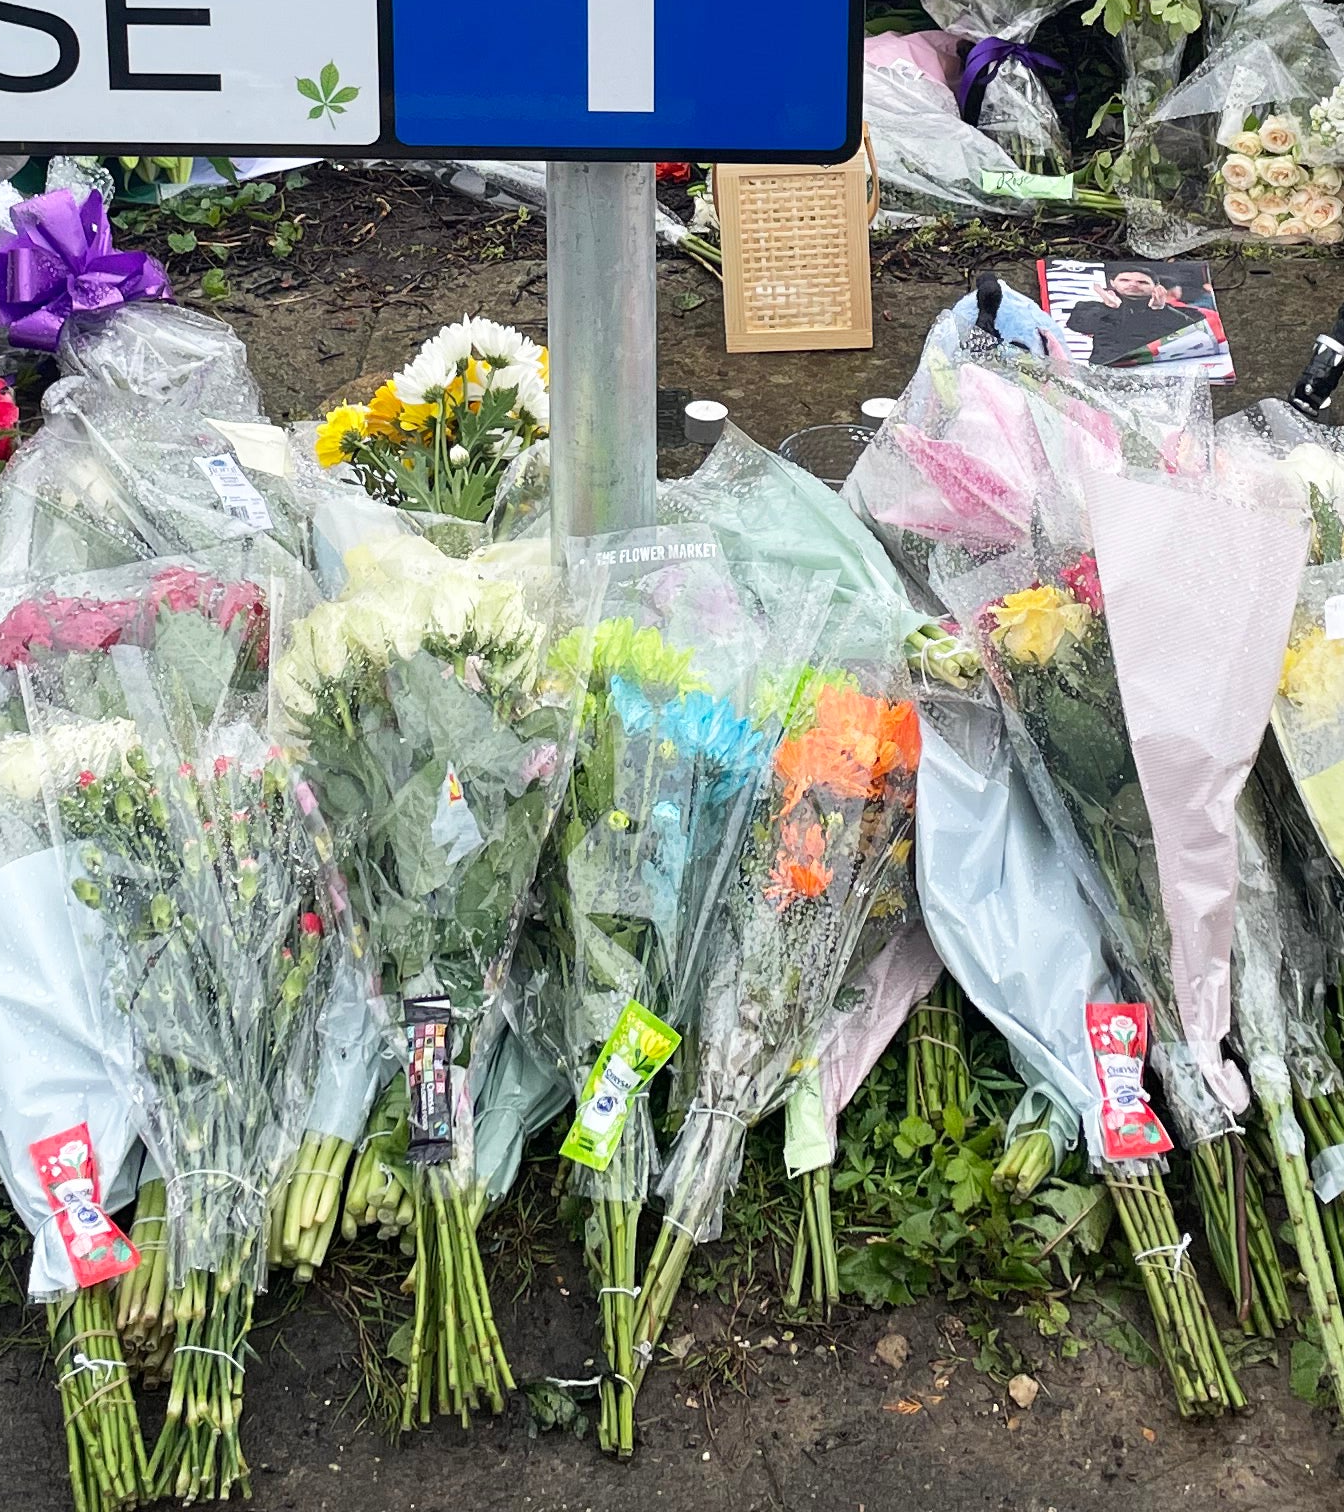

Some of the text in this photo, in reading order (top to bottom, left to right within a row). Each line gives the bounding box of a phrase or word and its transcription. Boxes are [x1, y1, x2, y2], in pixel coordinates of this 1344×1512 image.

[595, 542, 718, 565] THE FLOWER MARKET
